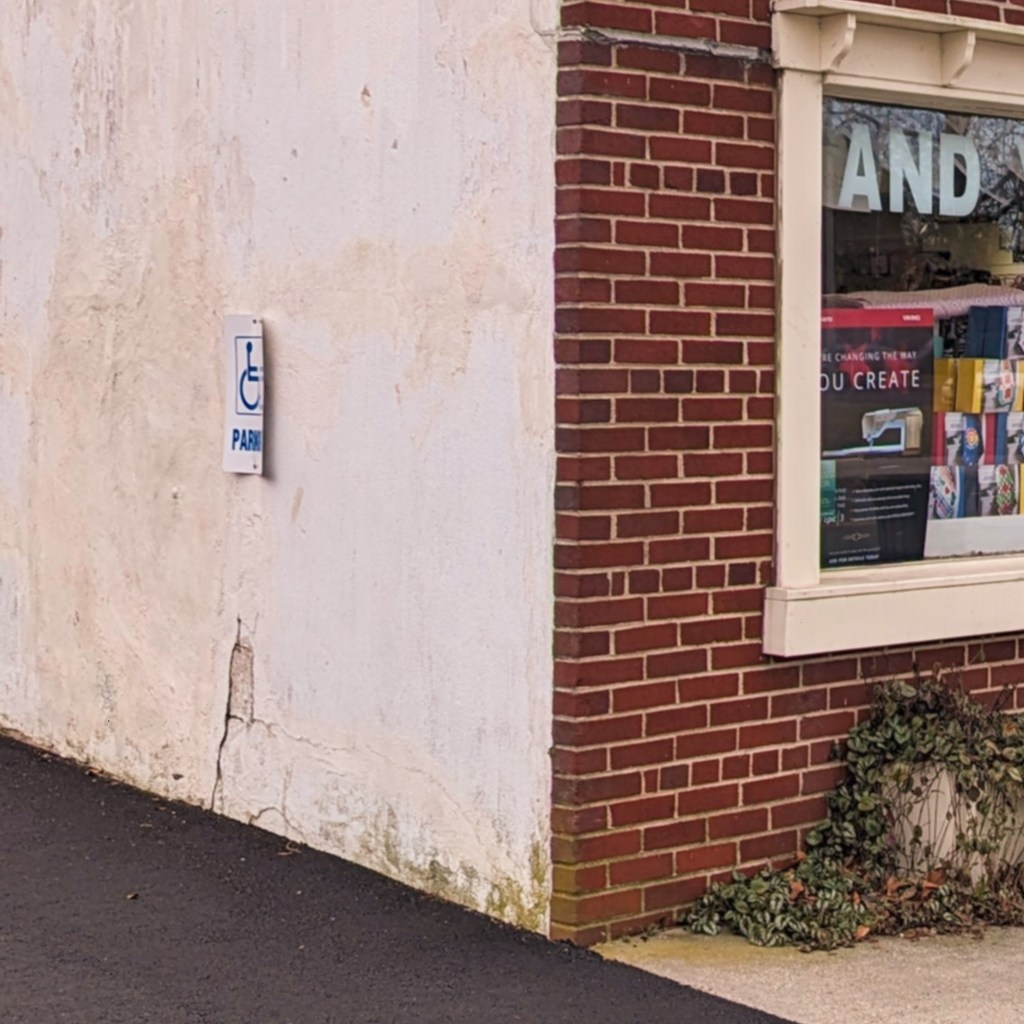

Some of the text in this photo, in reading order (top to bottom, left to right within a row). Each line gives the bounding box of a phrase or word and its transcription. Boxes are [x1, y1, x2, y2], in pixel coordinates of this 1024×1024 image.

[838, 123, 981, 217] AND
[834, 351, 880, 362] CHANGING
[882, 351, 898, 361] THE
[900, 350, 917, 359] WAY
[853, 370, 920, 390] CREATE
